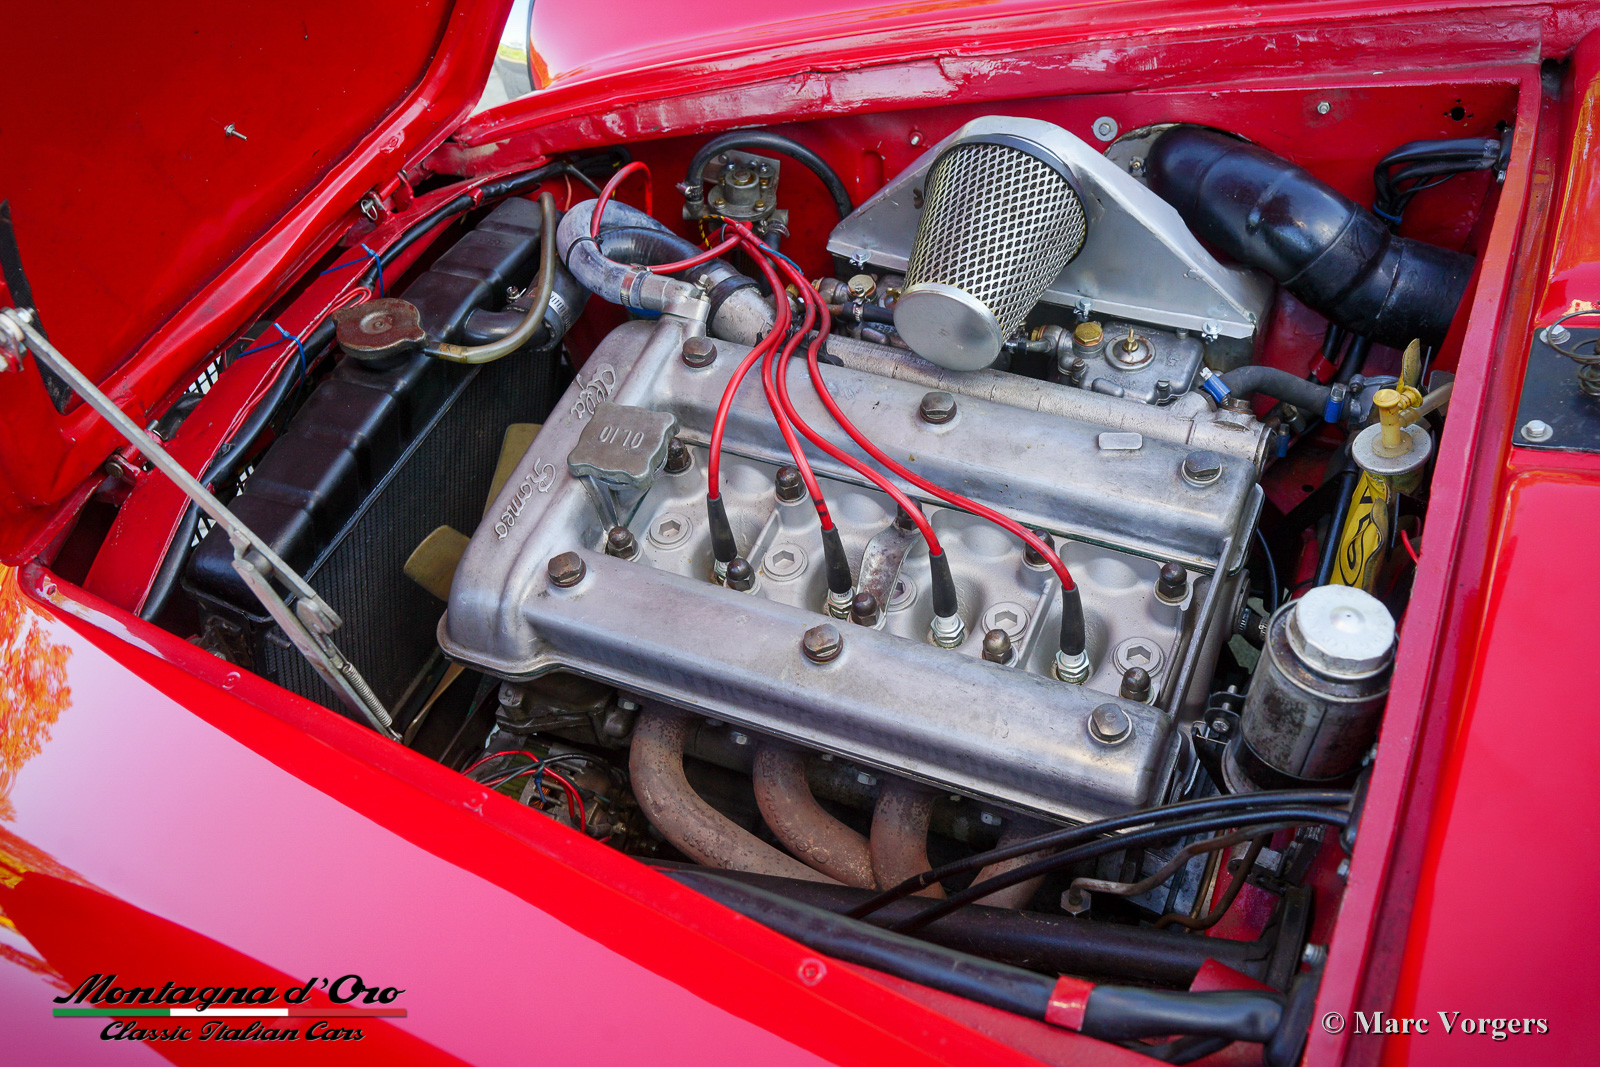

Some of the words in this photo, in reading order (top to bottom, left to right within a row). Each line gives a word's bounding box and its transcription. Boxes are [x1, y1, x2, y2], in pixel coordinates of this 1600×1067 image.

[570, 363, 617, 420] Alfa
[600, 425, 645, 449] OLIO
[494, 457, 557, 540] Romeo
